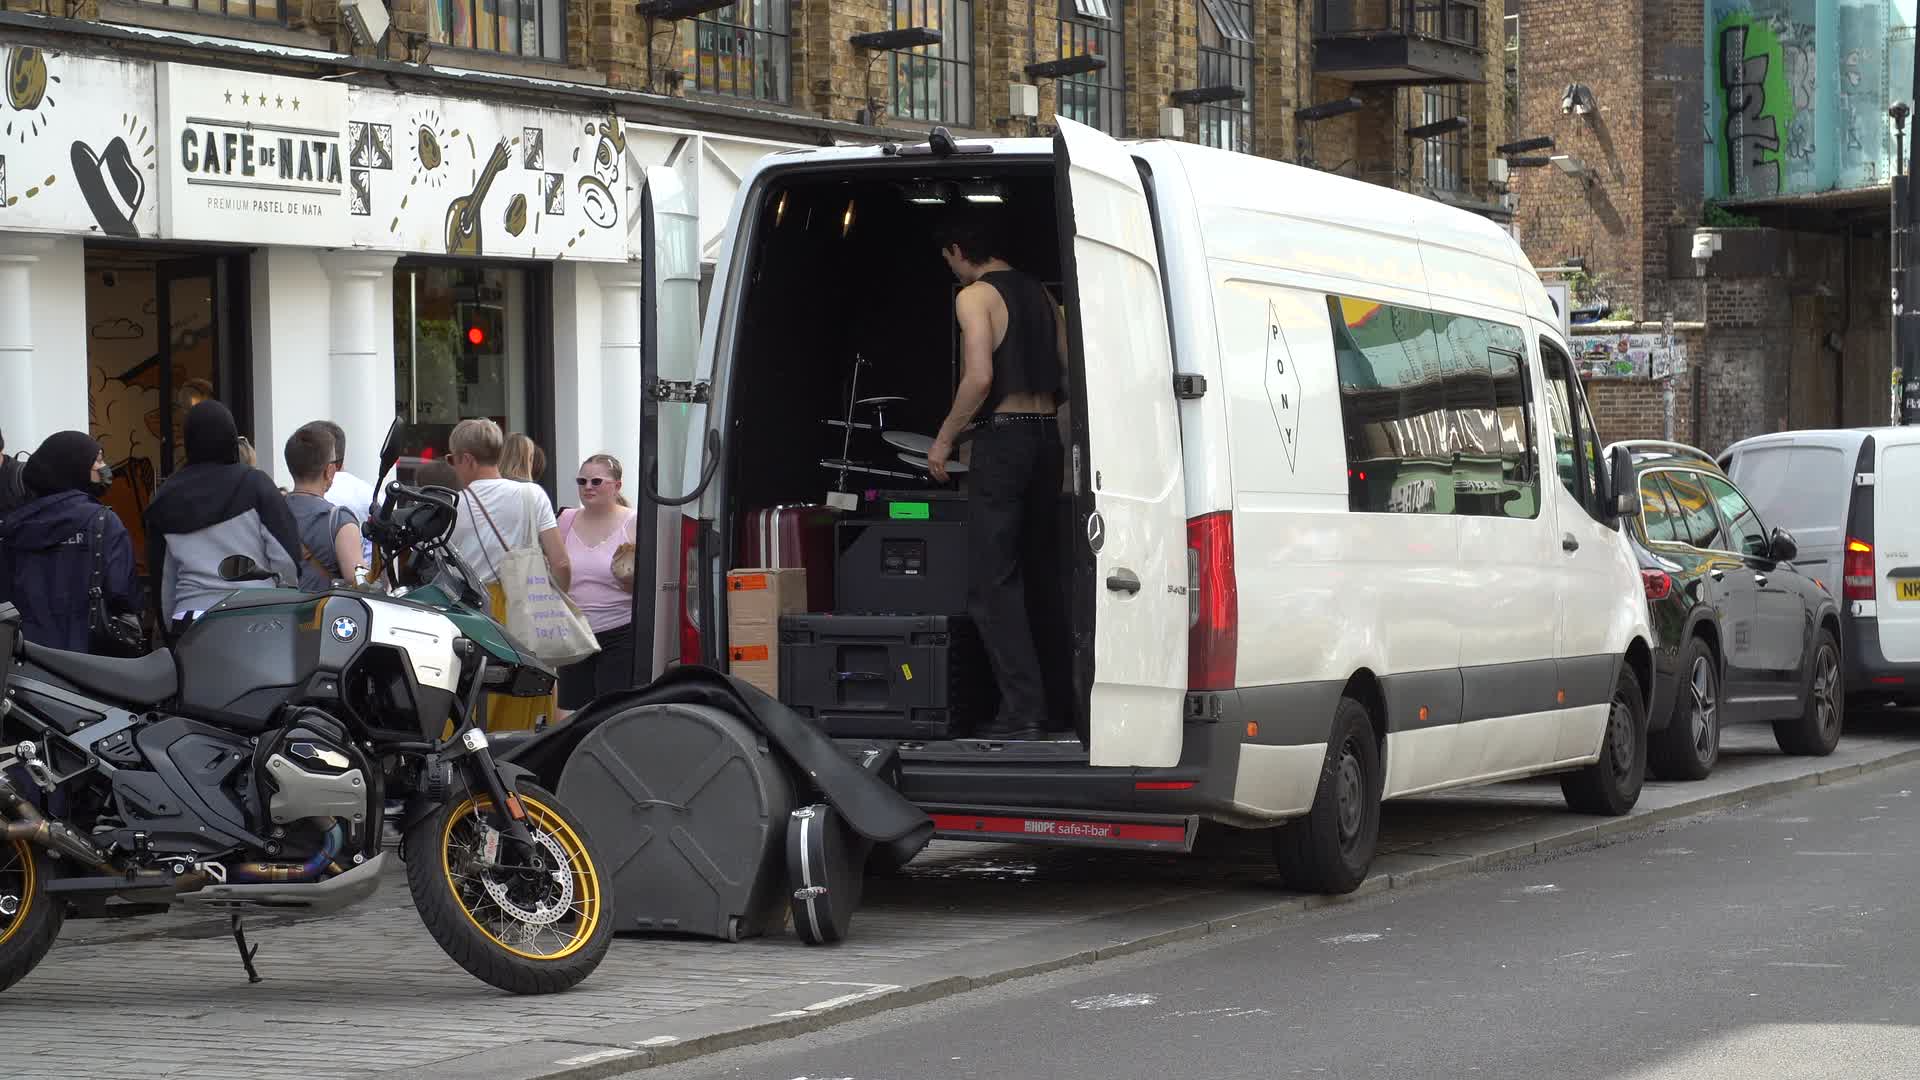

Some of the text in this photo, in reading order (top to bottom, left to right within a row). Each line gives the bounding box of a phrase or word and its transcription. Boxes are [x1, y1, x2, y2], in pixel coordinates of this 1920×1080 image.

[181, 122, 343, 184] CAFÉ DE NATA
[207, 197, 323, 217] PREMIUM PASTEL DE NATA
[1272, 325, 1292, 444] PONY
